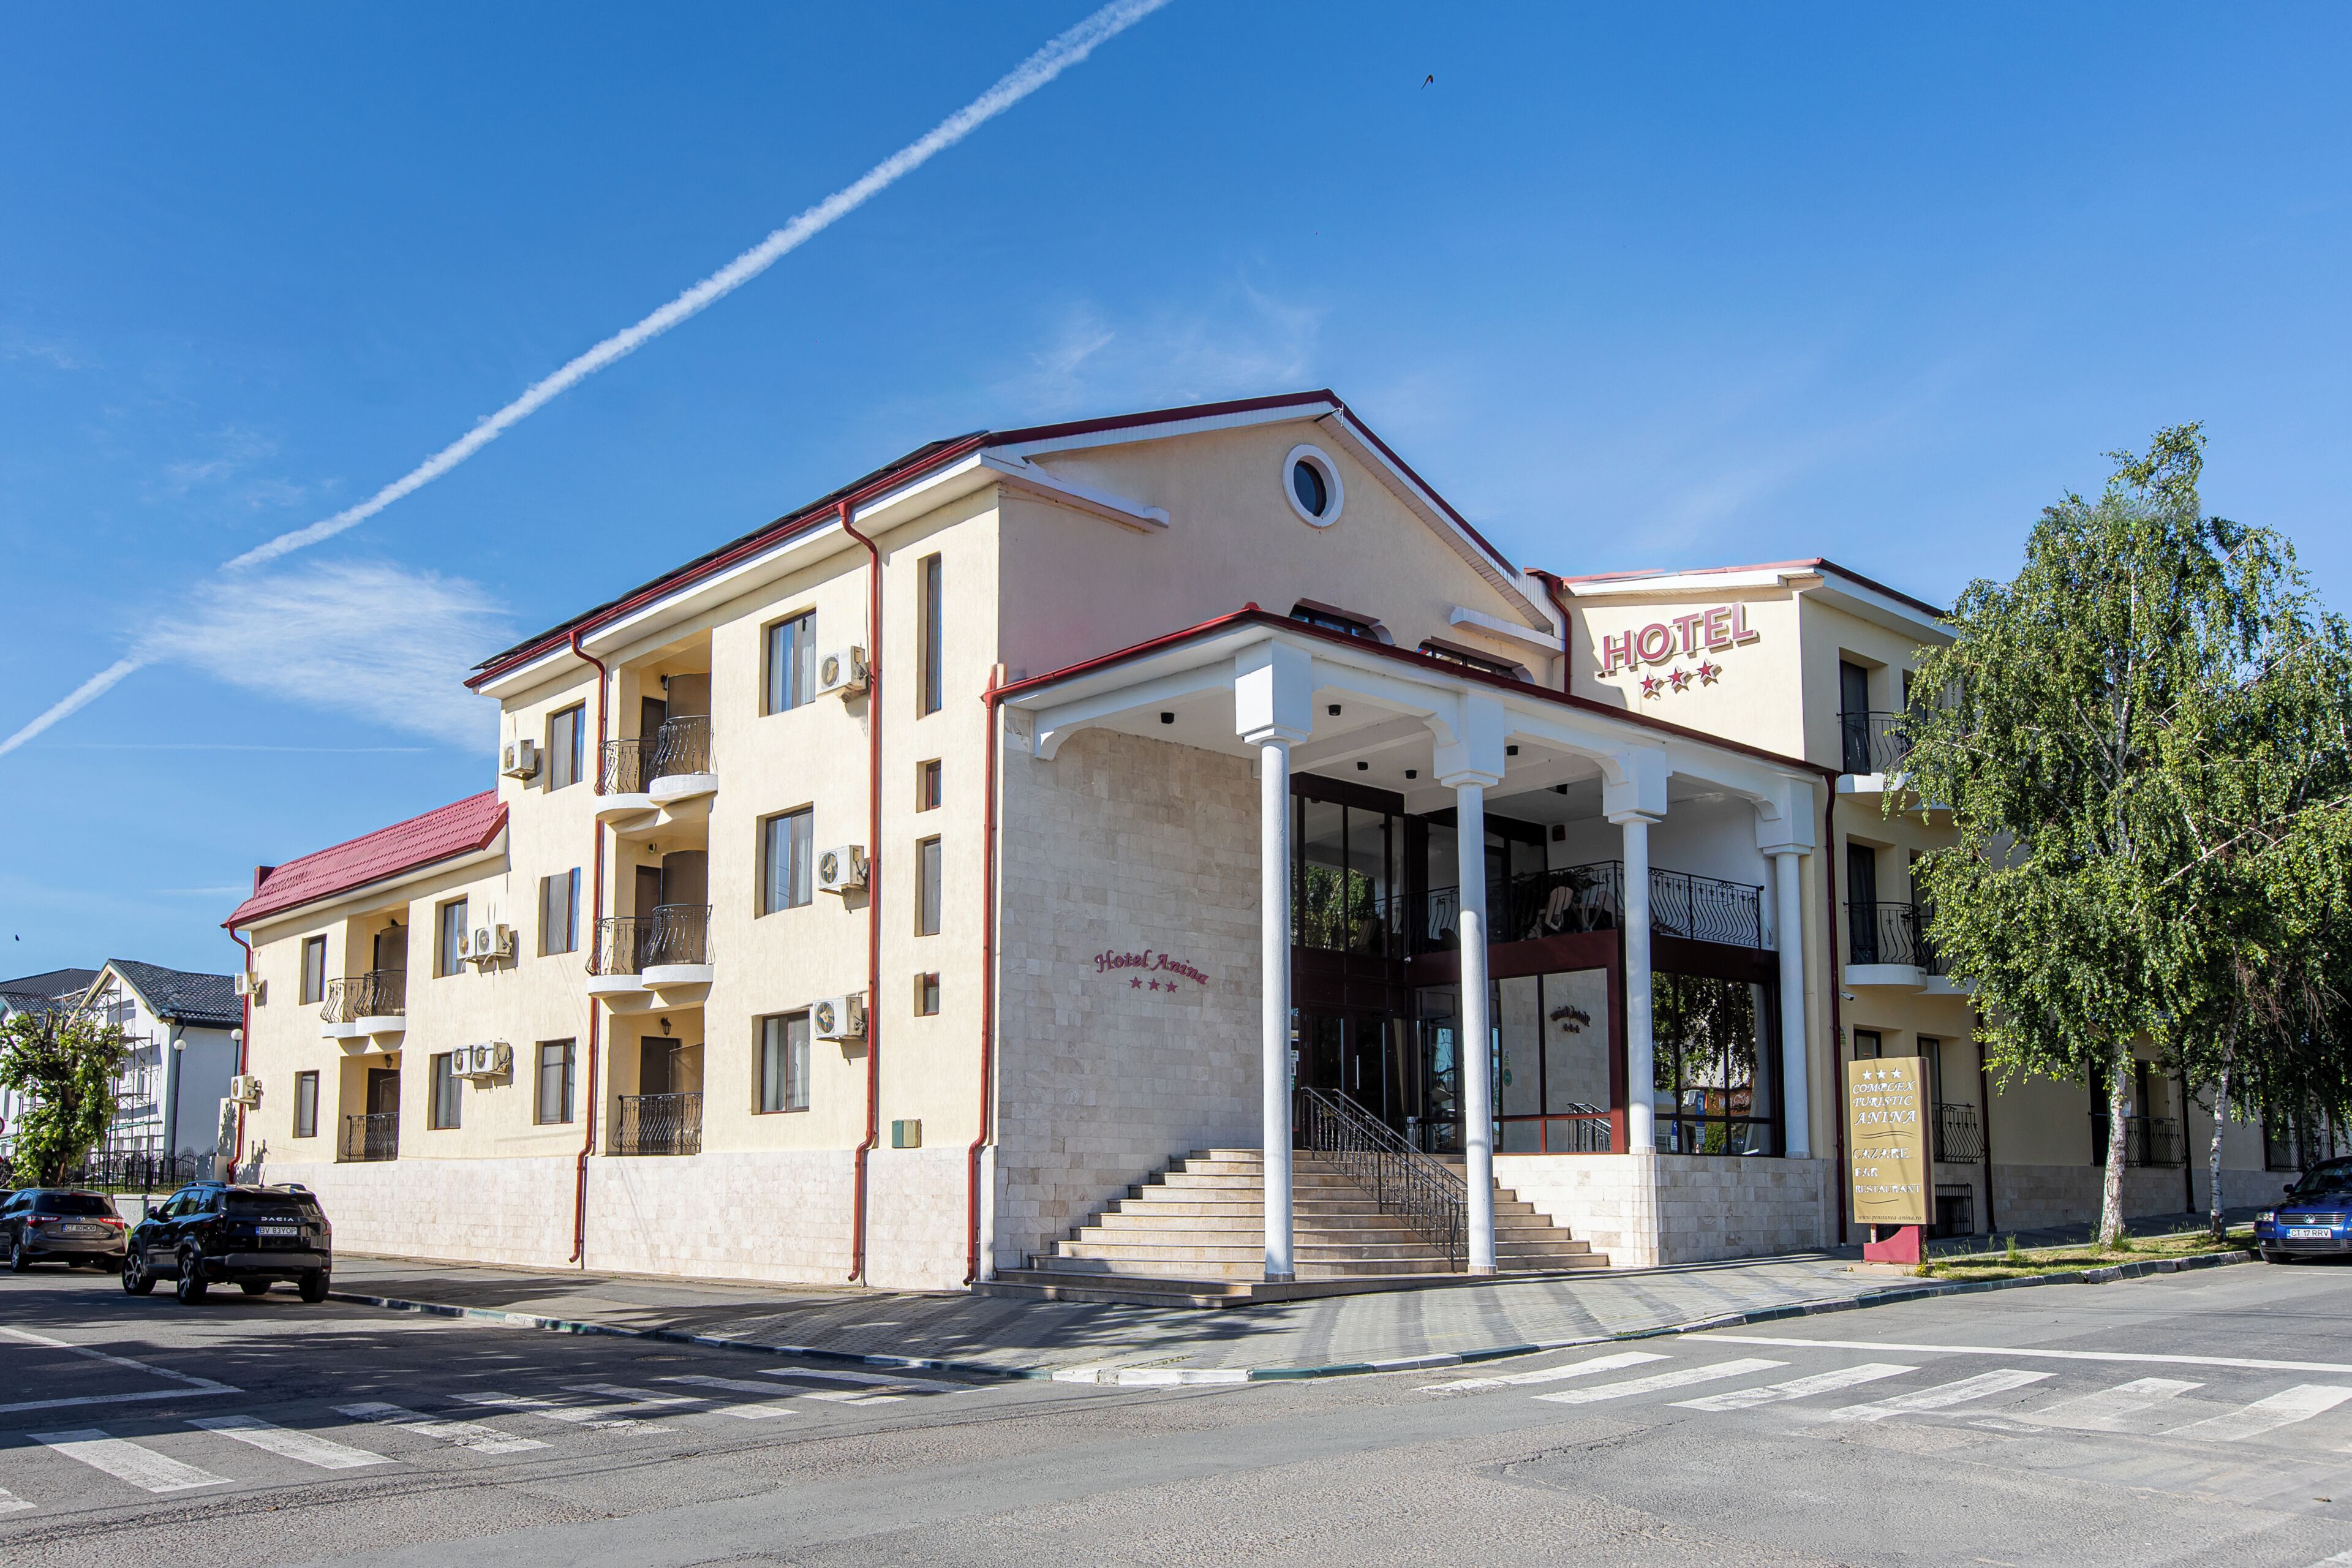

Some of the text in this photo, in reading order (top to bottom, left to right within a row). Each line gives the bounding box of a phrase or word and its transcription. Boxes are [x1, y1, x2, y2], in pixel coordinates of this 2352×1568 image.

[1603, 601, 1758, 671] HOTEL
[1094, 949, 1209, 985] Hotel Anina
[1852, 1080, 1916, 1095] COMPLEX
[1853, 1095, 1913, 1107] TURISTIC
[1854, 1110, 1917, 1126] ANINA
[1853, 1147, 1910, 1159] CAZARE
[1854, 1167, 1879, 1177] BAR
[1855, 1184, 1921, 1193] RESTAURANT
